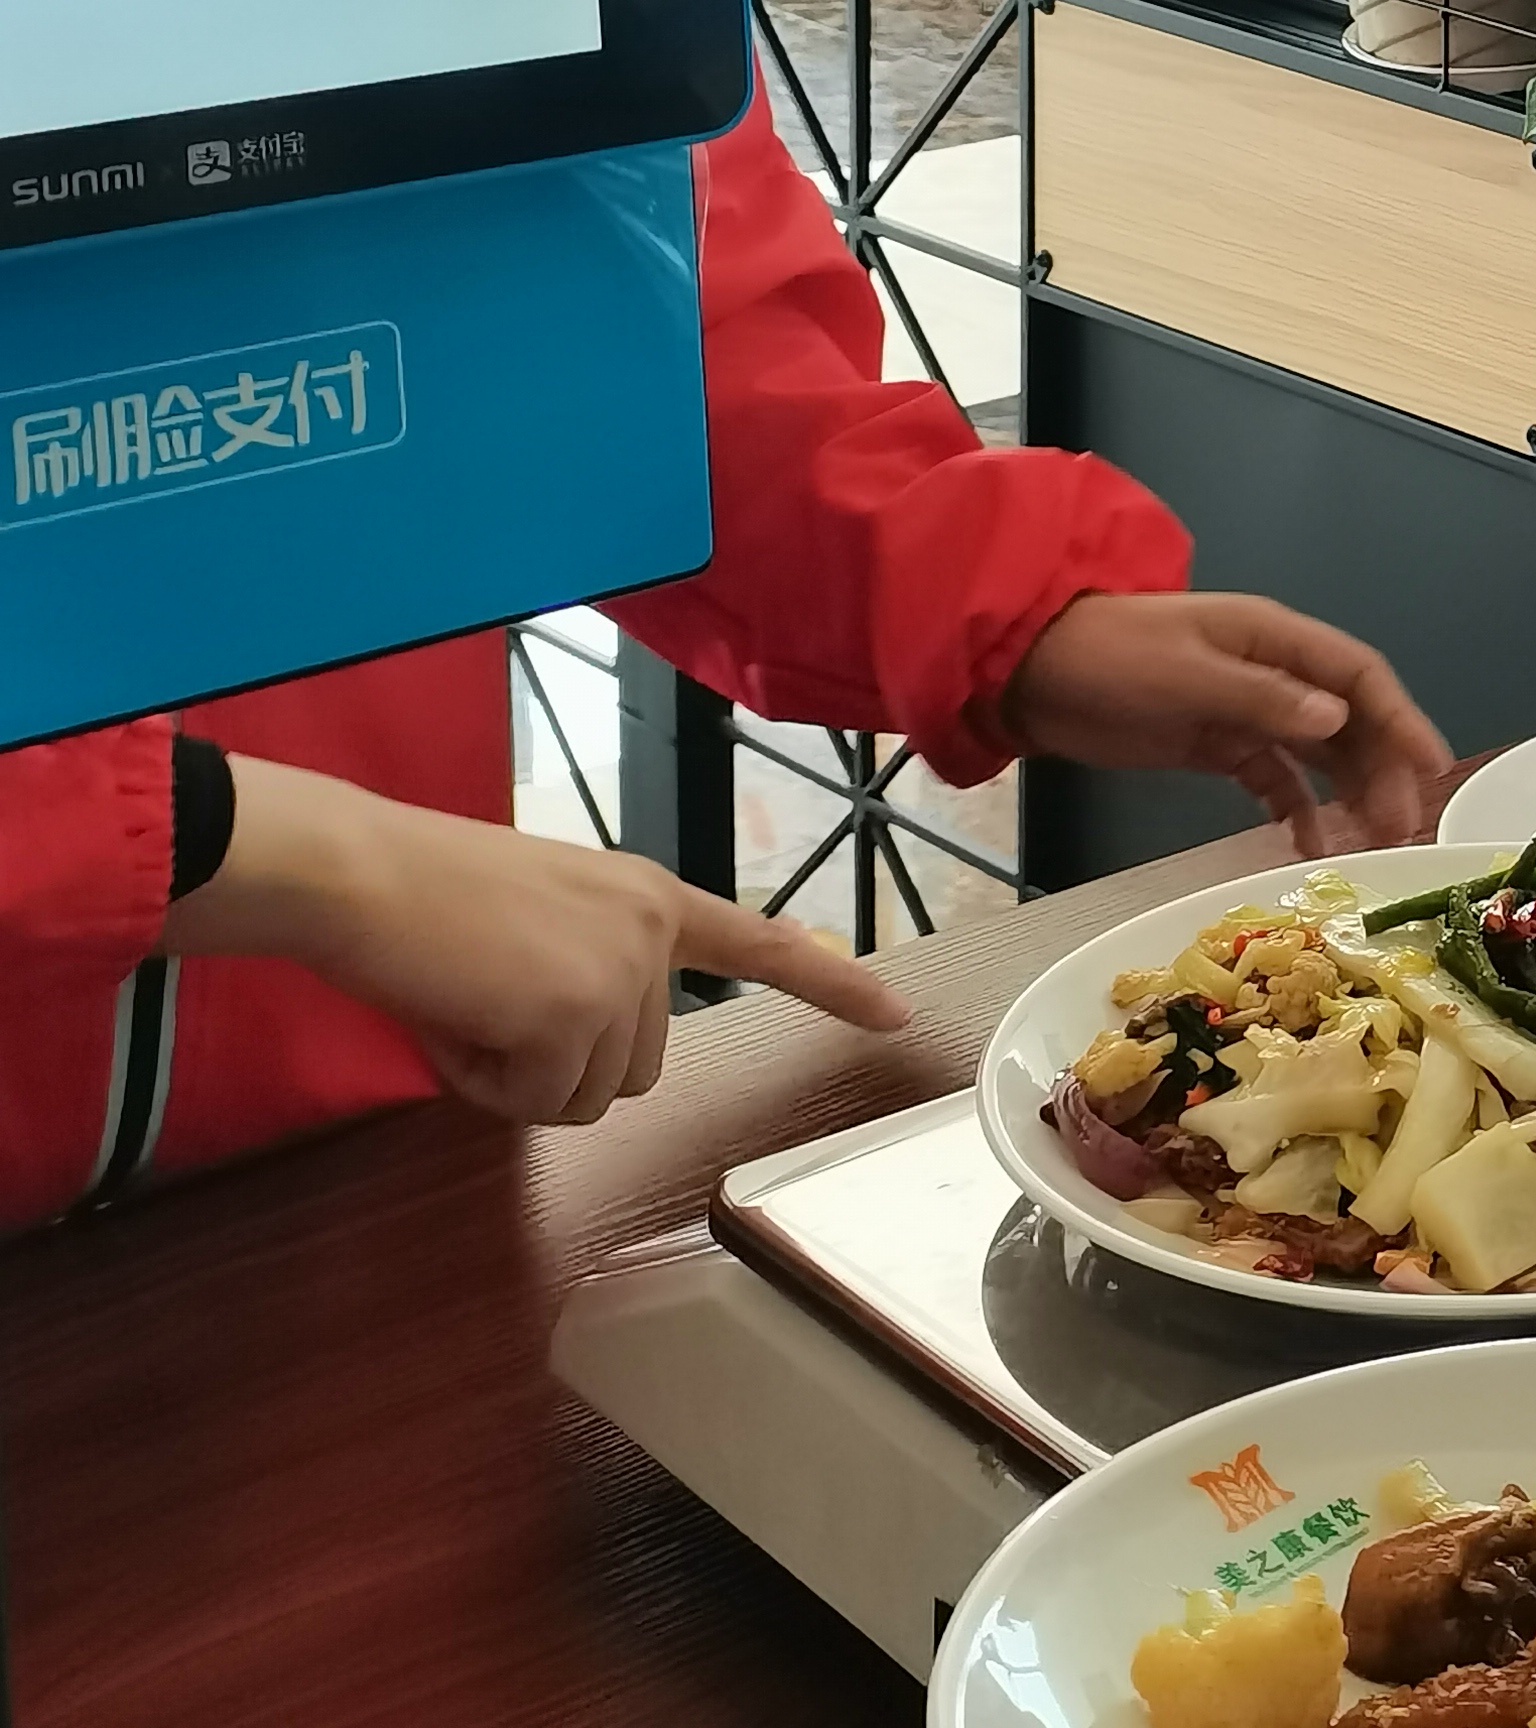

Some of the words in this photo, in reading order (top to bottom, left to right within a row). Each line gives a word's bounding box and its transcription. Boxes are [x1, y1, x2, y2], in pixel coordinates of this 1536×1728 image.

[12, 349, 370, 505] 刷脸支付
[1214, 1496, 1371, 1594] 美之康餐饮
